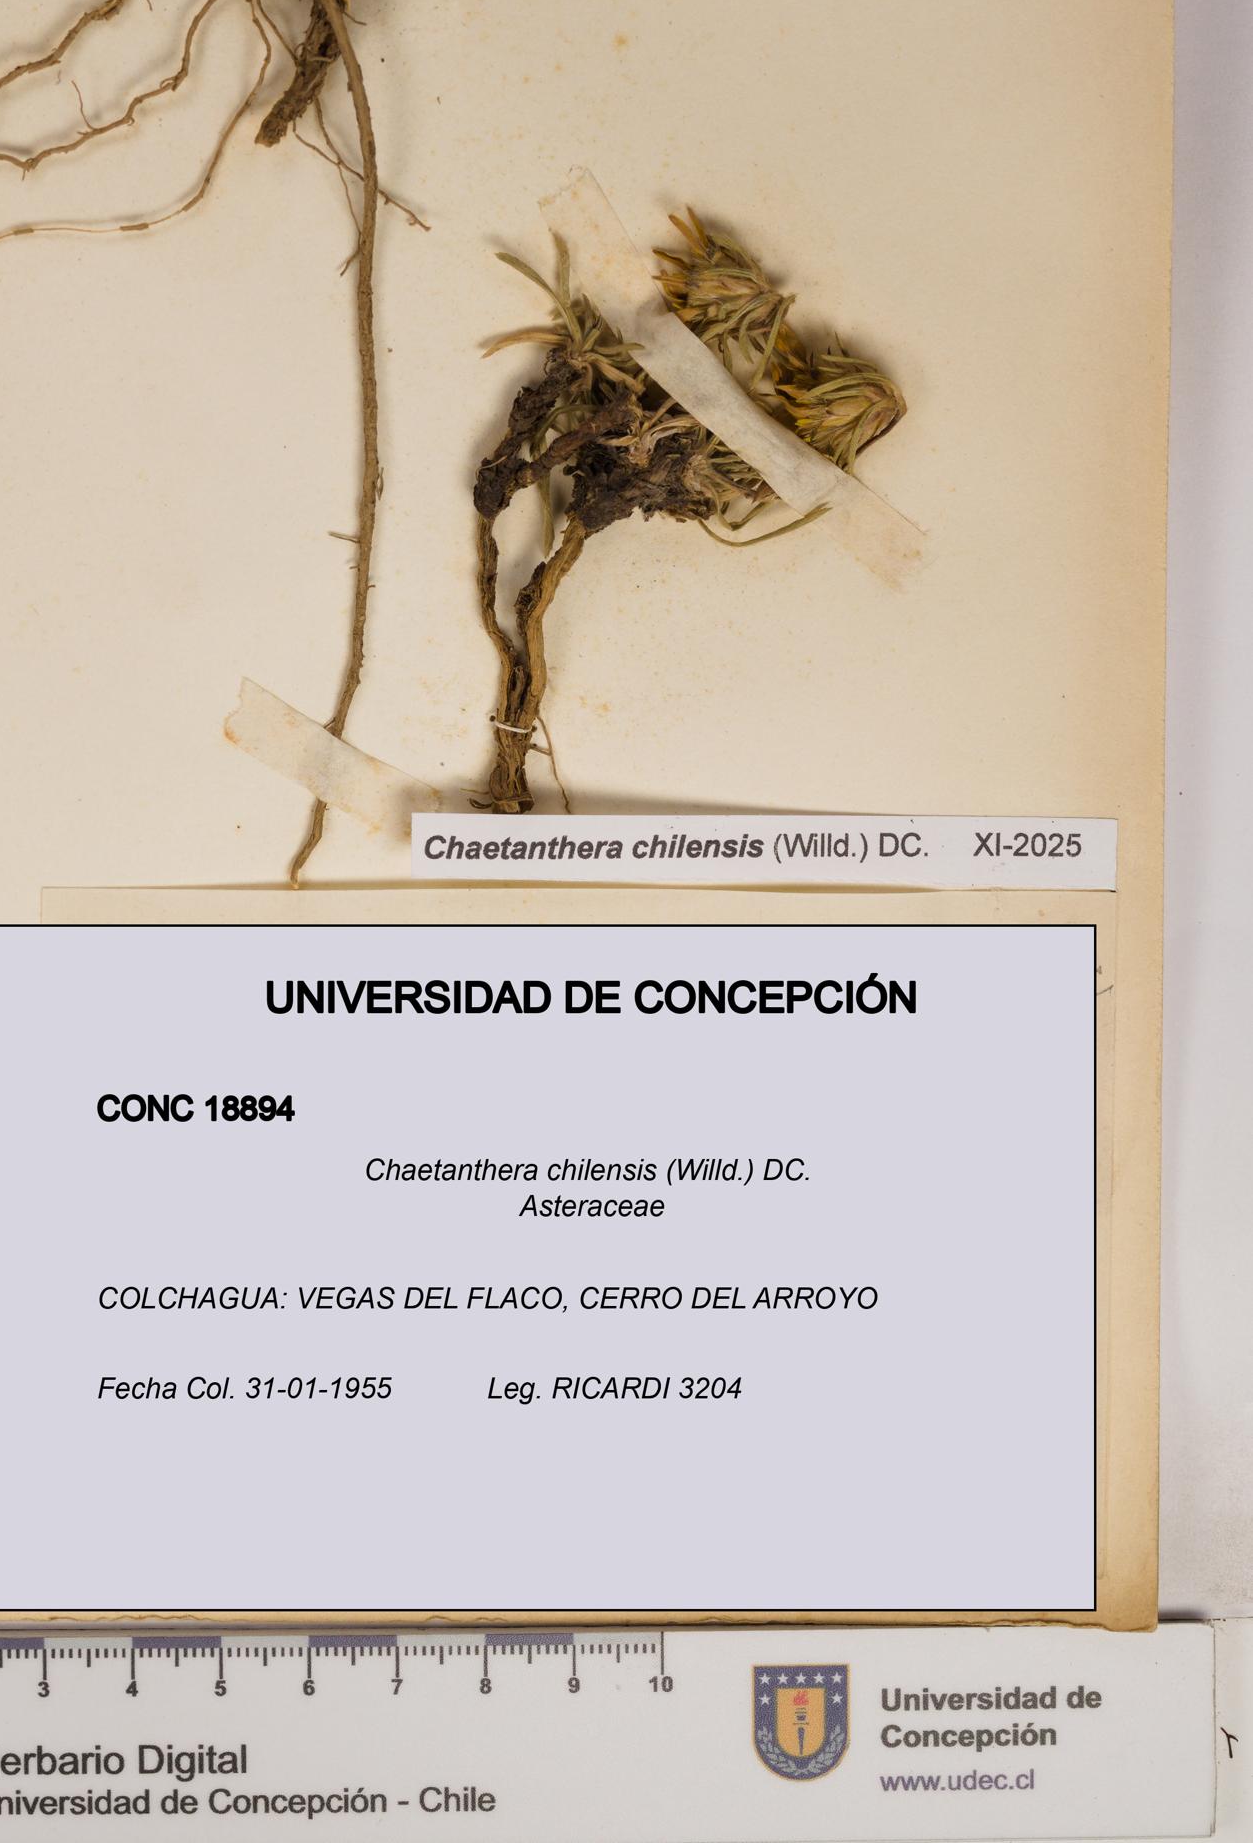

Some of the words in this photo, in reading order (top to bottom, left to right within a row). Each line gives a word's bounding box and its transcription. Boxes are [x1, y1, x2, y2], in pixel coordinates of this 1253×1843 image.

[424, 834, 624, 861] Chaetanthera
[632, 833, 765, 860] chilensis
[773, 832, 869, 864] (Willd.)
[878, 832, 929, 858] DC.
[973, 832, 1082, 858] XI-2025
[37, 1680, 50, 1698] 3
[125, 1680, 139, 1698] 4
[214, 1679, 227, 1697] 5
[302, 1679, 316, 1697] 6
[391, 1678, 404, 1696] 7
[479, 1677, 493, 1695] 8
[567, 1676, 581, 1694] 9
[648, 1675, 674, 1693] 10
[881, 1685, 1057, 1712] Universidad
[1066, 1685, 1102, 1710] de
[880, 1722, 1057, 1753] Concepción
[138, 1743, 247, 1783] Digital
[879, 1768, 1035, 1792] www.udec.cl
[160, 1788, 199, 1815] de
[208, 1787, 387, 1820] Concepción
[419, 1786, 496, 1813] Chile
